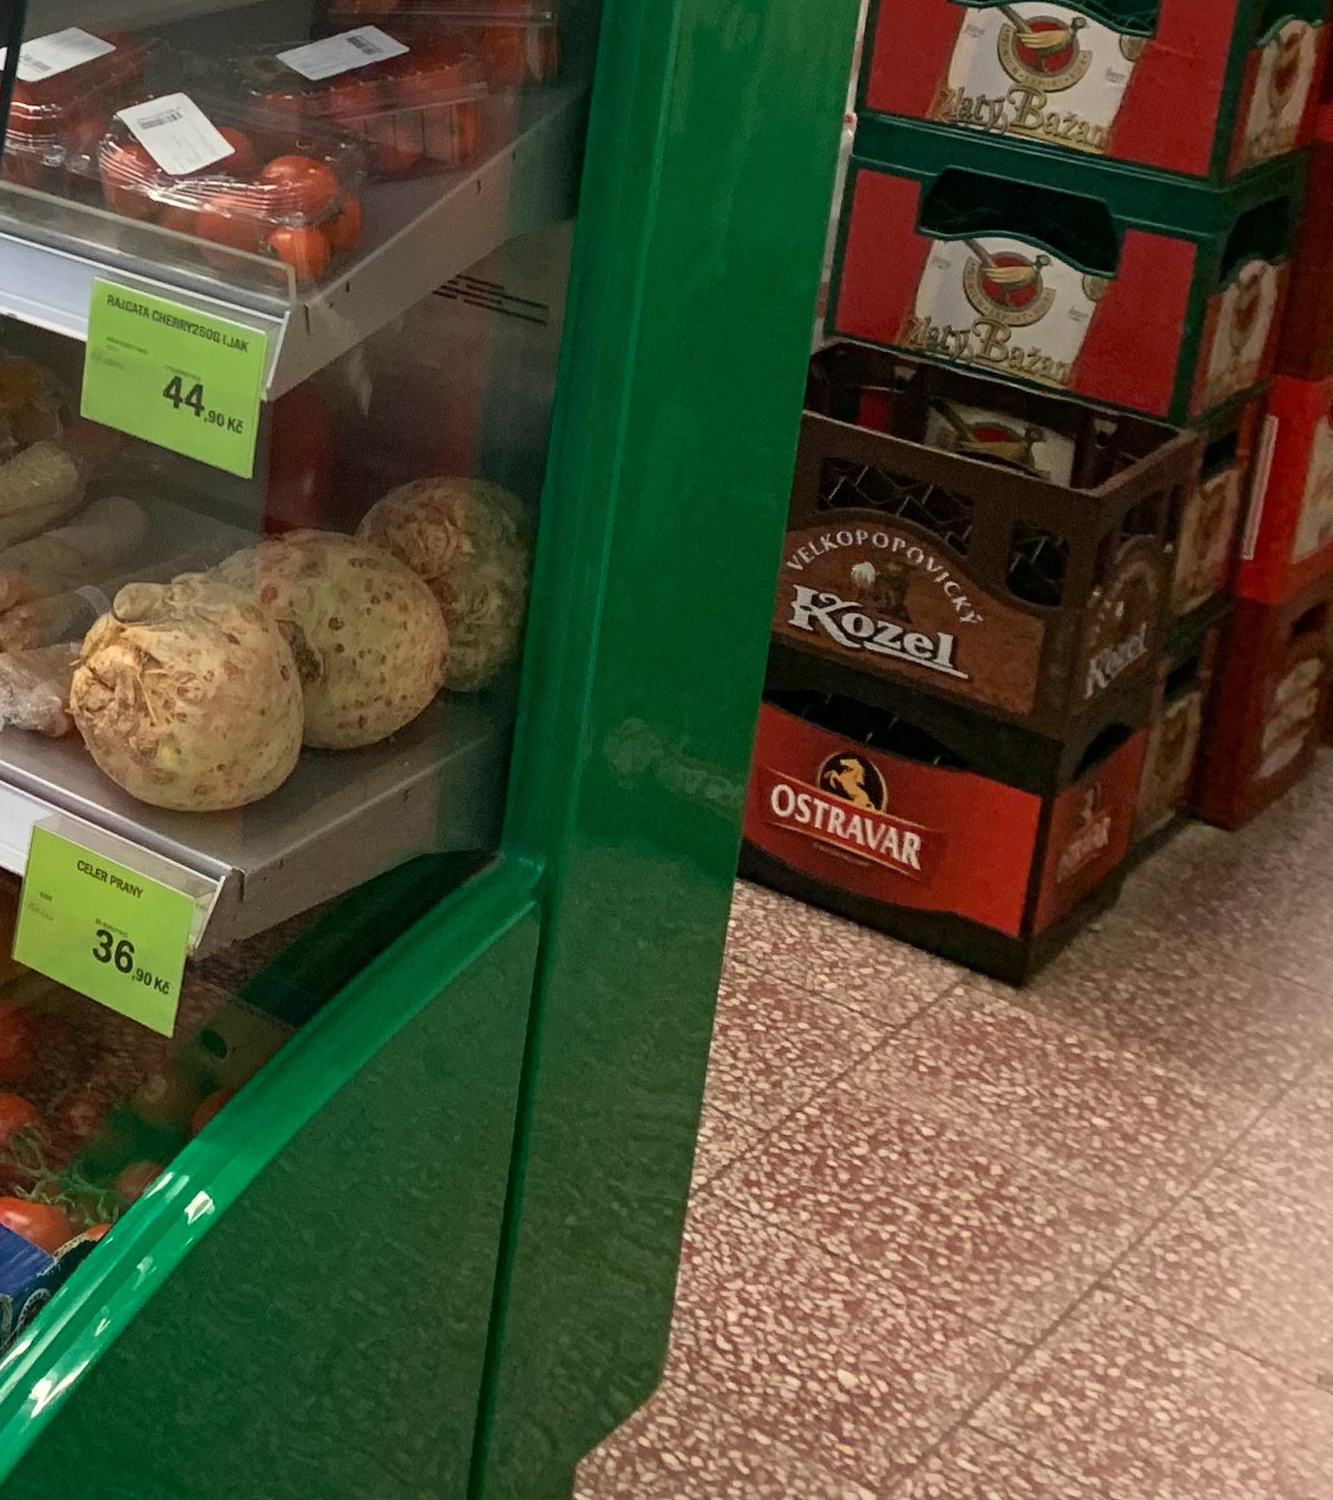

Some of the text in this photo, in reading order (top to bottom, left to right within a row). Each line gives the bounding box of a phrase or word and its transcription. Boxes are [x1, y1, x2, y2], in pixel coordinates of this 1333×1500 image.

[162, 374, 244, 434] 44,90 Kč
[788, 585, 969, 679] Kozel
[770, 783, 923, 870] OSTRAVAR
[76, 859, 144, 899] CELER PRANY
[92, 928, 170, 996] 36,90 Kč
